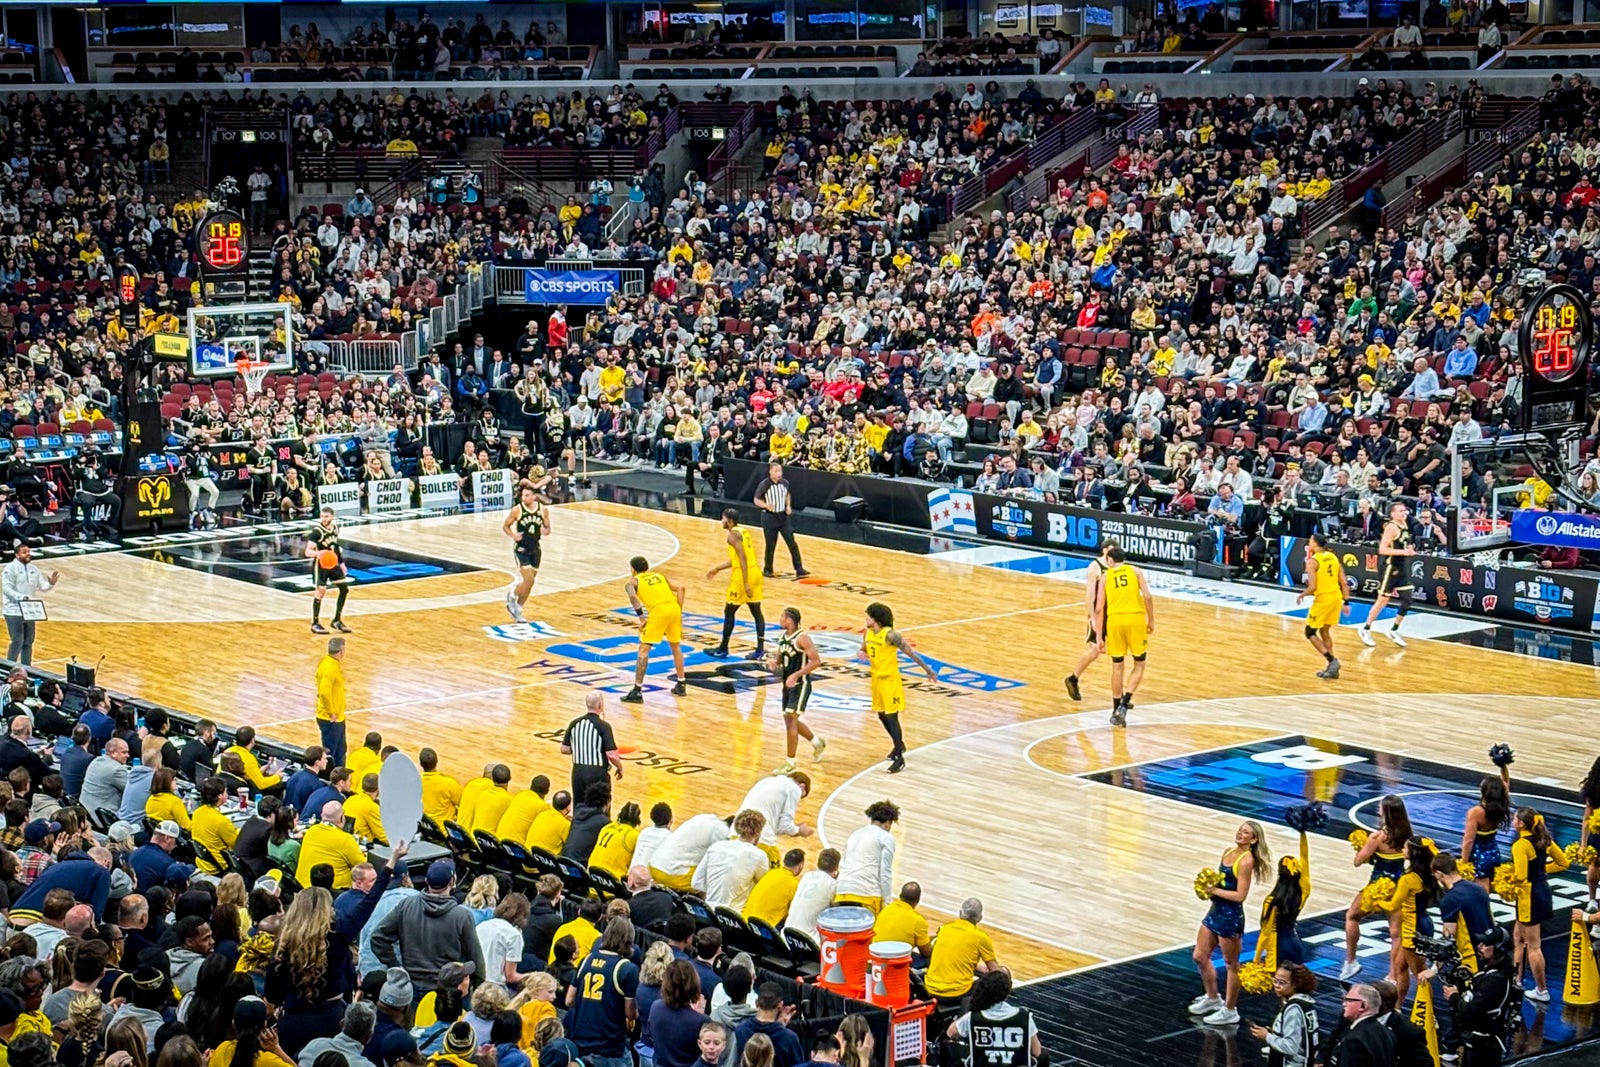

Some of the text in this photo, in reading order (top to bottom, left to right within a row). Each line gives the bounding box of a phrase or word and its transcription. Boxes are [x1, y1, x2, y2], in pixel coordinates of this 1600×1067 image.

[221, 130, 236, 141] 107
[209, 222, 241, 238] 17:19
[210, 238, 241, 264] 26
[541, 280, 615, 293] CBS SPORTS
[1538, 304, 1576, 331] 17:19
[1535, 330, 1571, 371] 26
[480, 471, 503, 483] CHOO
[377, 480, 402, 492] CHOO
[421, 481, 458, 494] BOILERS
[481, 483, 504, 495] CHOO
[320, 490, 358, 504] BOILERS
[377, 493, 402, 504] CHOO
[138, 508, 174, 517] RAM
[1101, 519, 1124, 531] 2026
[1125, 523, 1145, 536] TIAA
[1556, 521, 1600, 539] Allstate
[645, 576, 662, 586] 23
[1114, 574, 1128, 588] 15
[1459, 568, 1473, 585] N
[1484, 570, 1496, 590] N
[599, 831, 614, 848] 11
[821, 940, 837, 964] G
[1570, 931, 1583, 997] MICHIGAN
[871, 965, 882, 983] G
[583, 972, 605, 1000] 12
[985, 1050, 1015, 1064] TV
